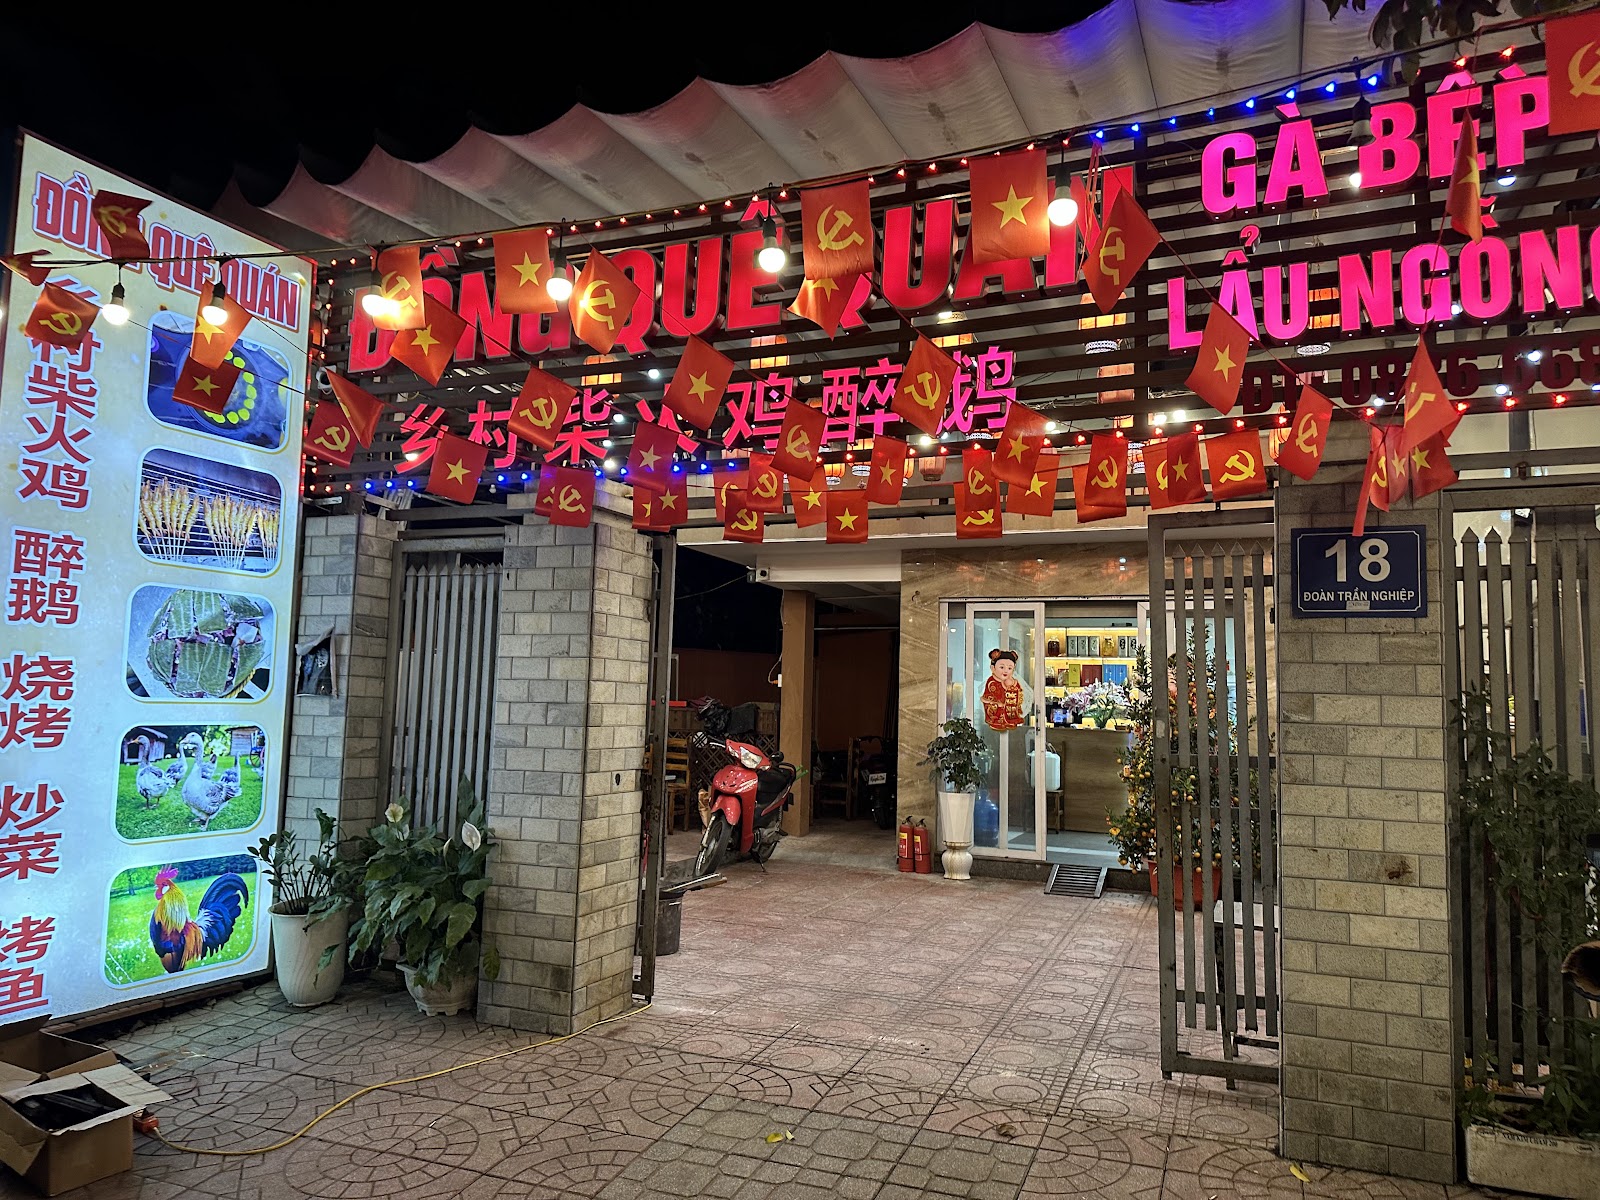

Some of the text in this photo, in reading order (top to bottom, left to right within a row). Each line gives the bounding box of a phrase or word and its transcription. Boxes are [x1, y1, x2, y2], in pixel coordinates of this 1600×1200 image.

[1200, 102, 1330, 214] GÀ
[220, 255, 300, 330] QUÁN
[608, 200, 784, 355] QUÊ
[1168, 195, 1600, 350] LẨU NGỖN
[1342, 349, 1480, 404] 086
[8, 529, 84, 624] 醉鹅
[1303, 587, 1415, 603] ĐOÀN TRẦN NGHIỆP
[1325, 538, 1391, 582] 18
[0, 655, 73, 748] 烧烤
[0, 783, 64, 880] 炒菜
